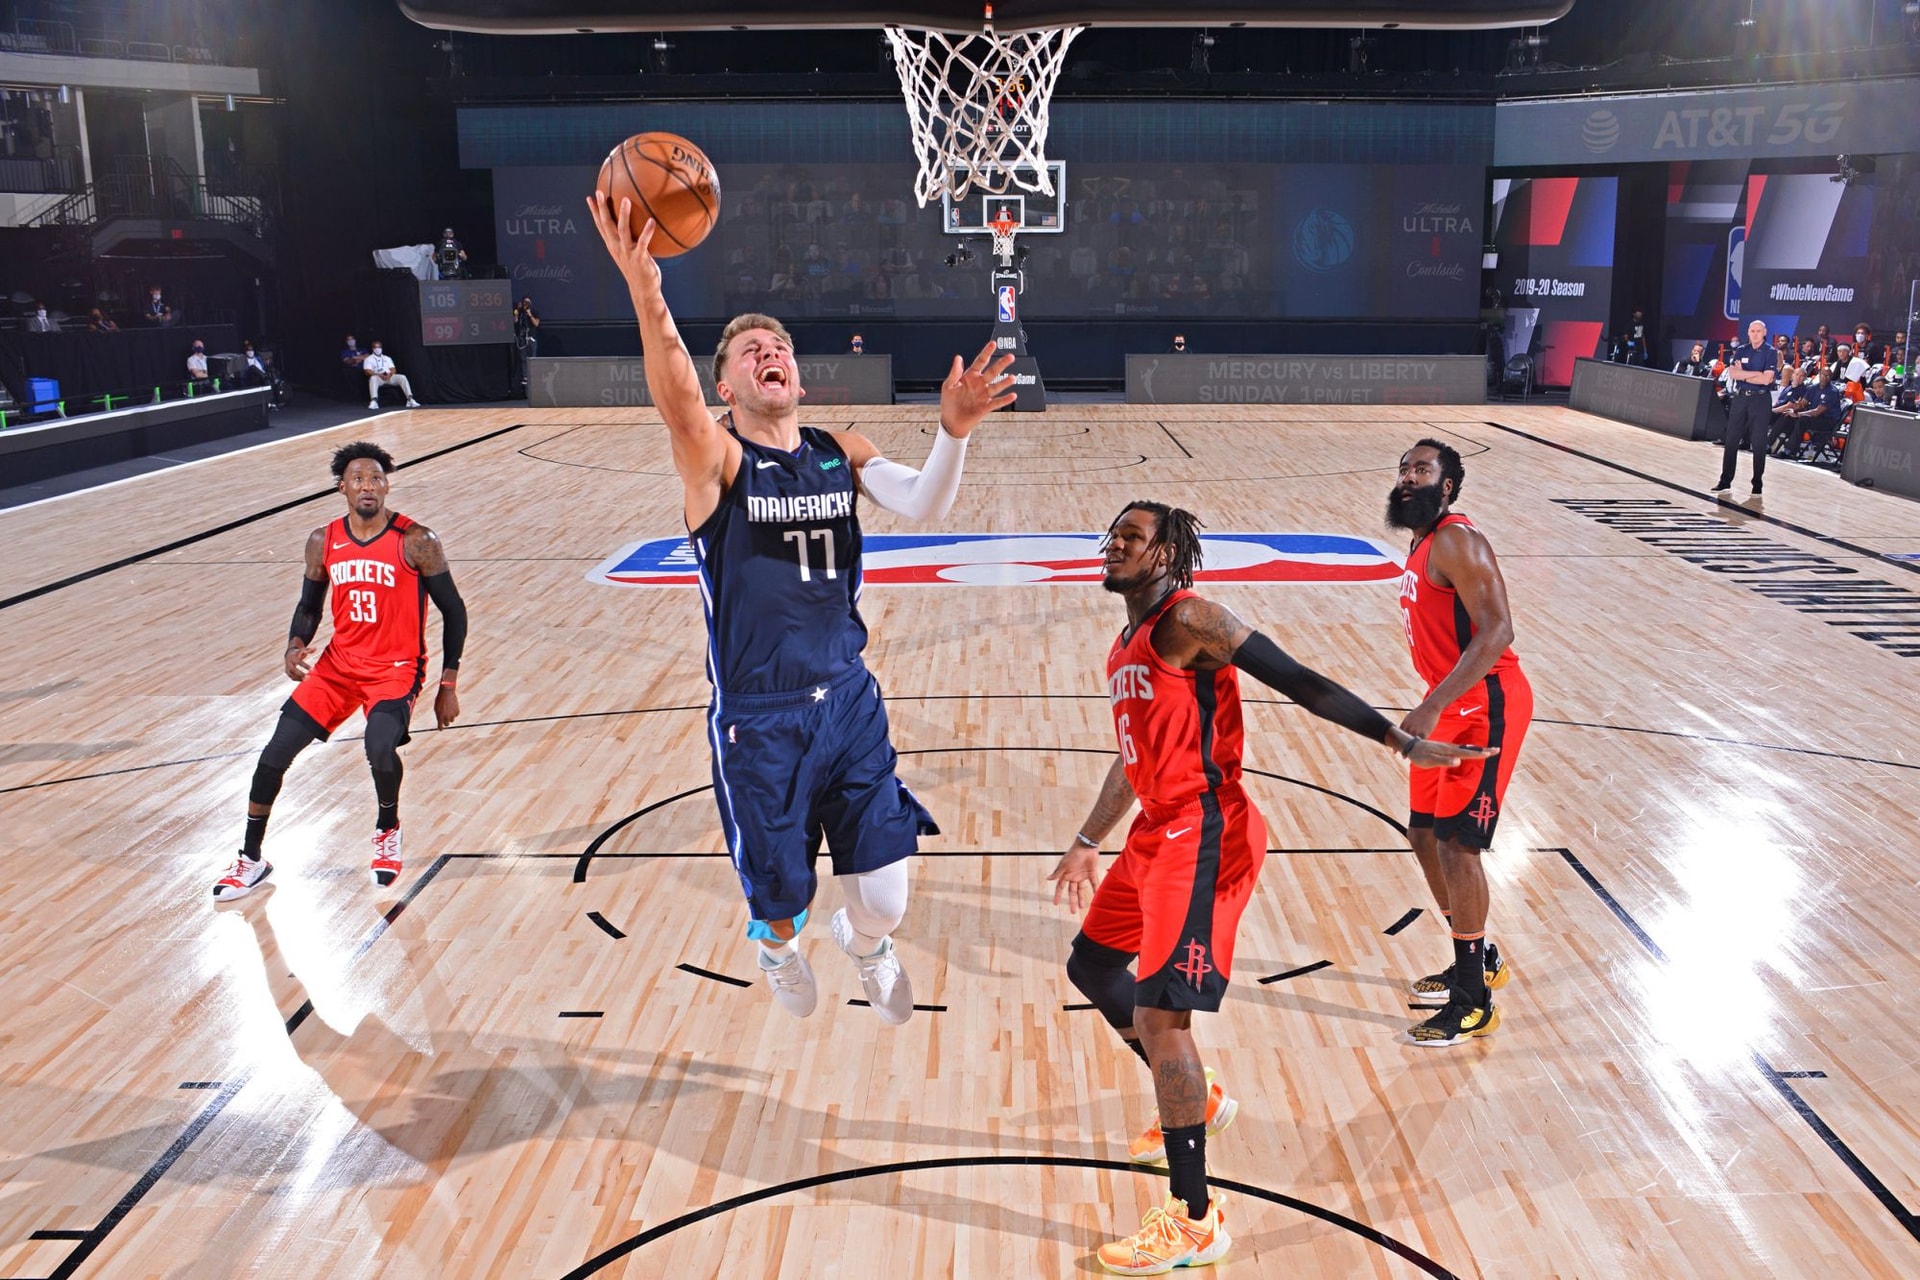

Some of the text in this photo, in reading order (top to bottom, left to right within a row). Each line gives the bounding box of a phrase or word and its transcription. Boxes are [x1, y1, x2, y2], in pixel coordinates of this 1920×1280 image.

[1653, 102, 1847, 149] AT&T 5G
[506, 219, 577, 235] ULTRA
[1403, 217, 1473, 233] ULTRA
[1514, 278, 1585, 296] 2019-20 Season
[1770, 283, 1855, 302] #WholeNewGame
[428, 293, 455, 307] 105
[470, 293, 502, 306] 3:36
[435, 325, 453, 338] 99
[471, 323, 480, 336] 3
[997, 336, 1017, 349] @NBA
[1208, 361, 1317, 379] MERCURY
[1349, 363, 1437, 380] LIBERTY
[1199, 384, 1289, 402] SUNDAY
[1863, 444, 1913, 473] WNBA
[783, 528, 837, 582] 77
[330, 559, 396, 588] ROCKETS
[349, 590, 377, 623] 33
